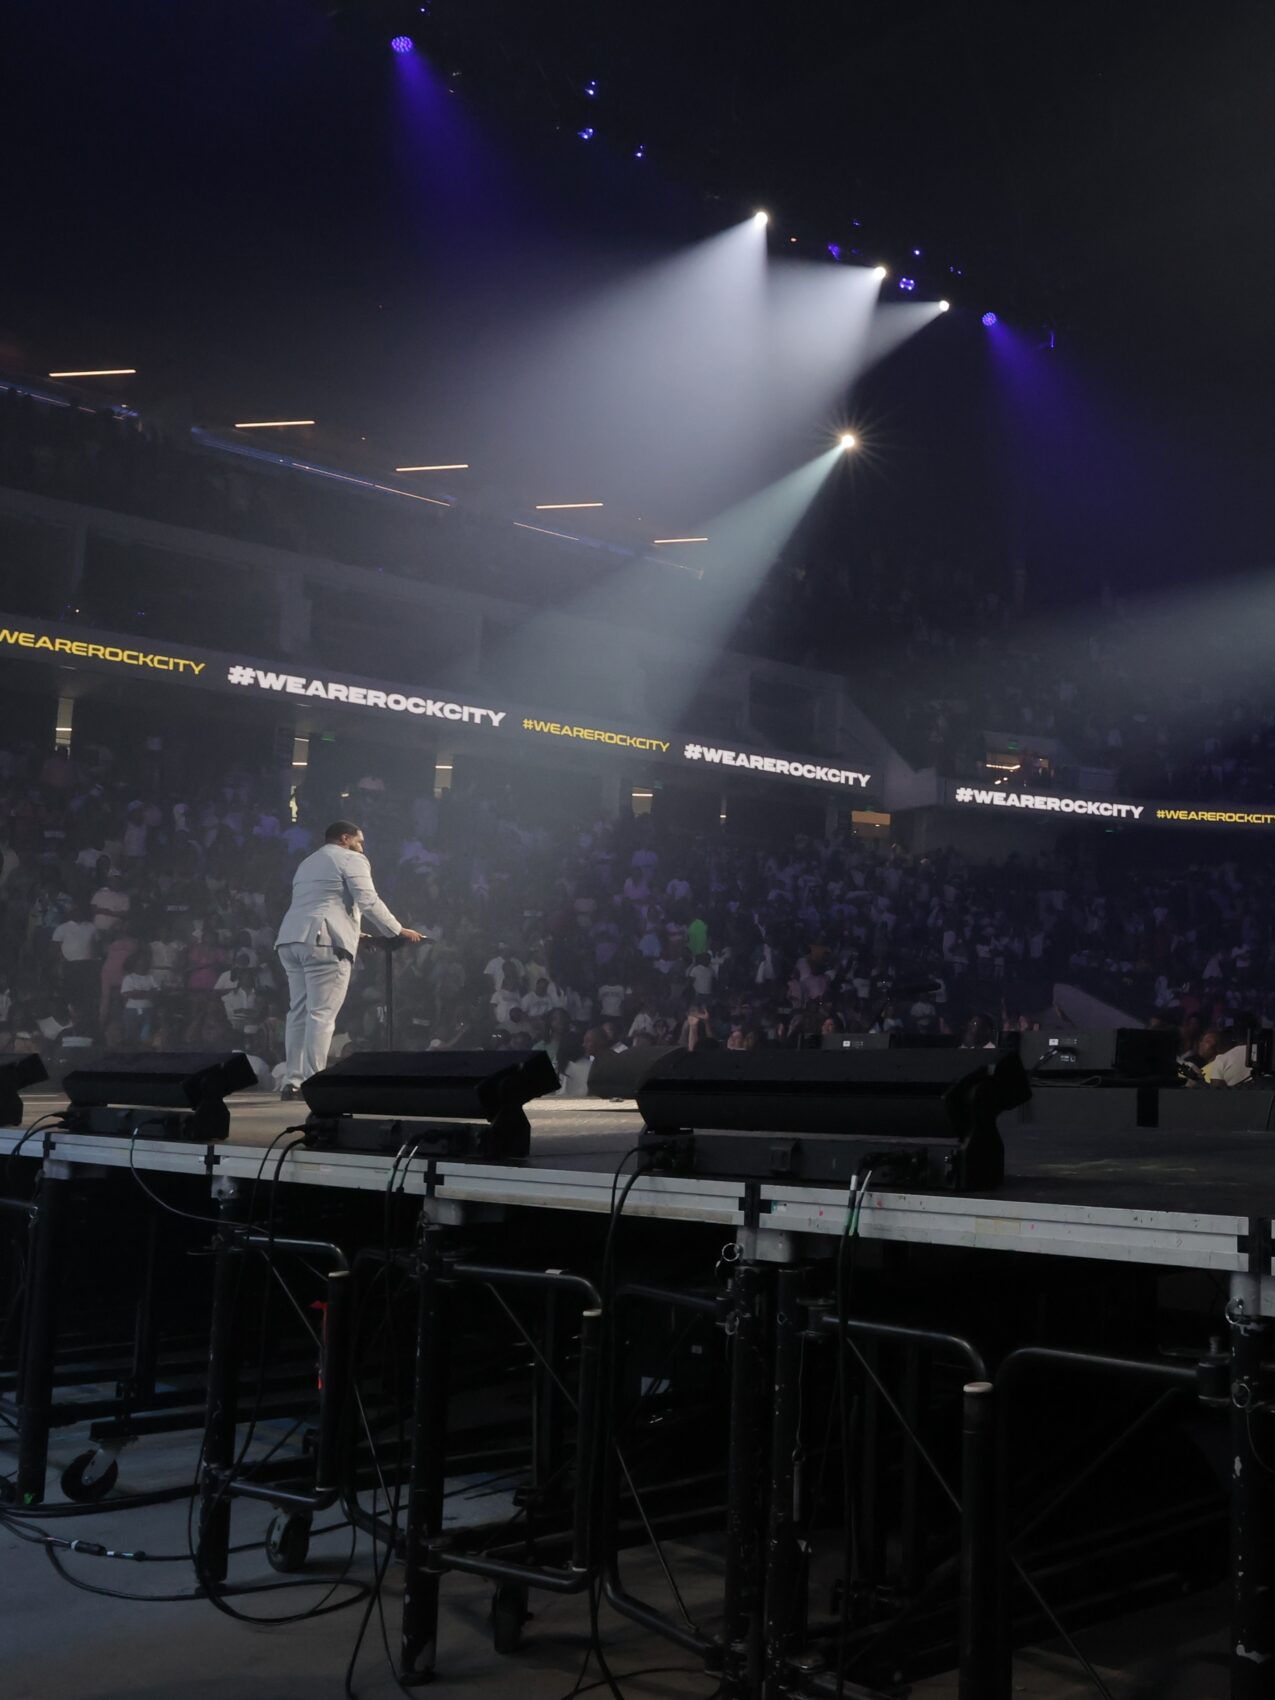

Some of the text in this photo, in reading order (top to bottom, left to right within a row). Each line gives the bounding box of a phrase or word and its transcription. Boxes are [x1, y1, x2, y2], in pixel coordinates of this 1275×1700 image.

[228, 665, 506, 727] #WEAREROCKCITY
[522, 718, 670, 752] #WEAREROCKCITY
[684, 744, 871, 788] #WEAREROCKCITY
[956, 787, 1144, 819] #WEAREROCKCITY
